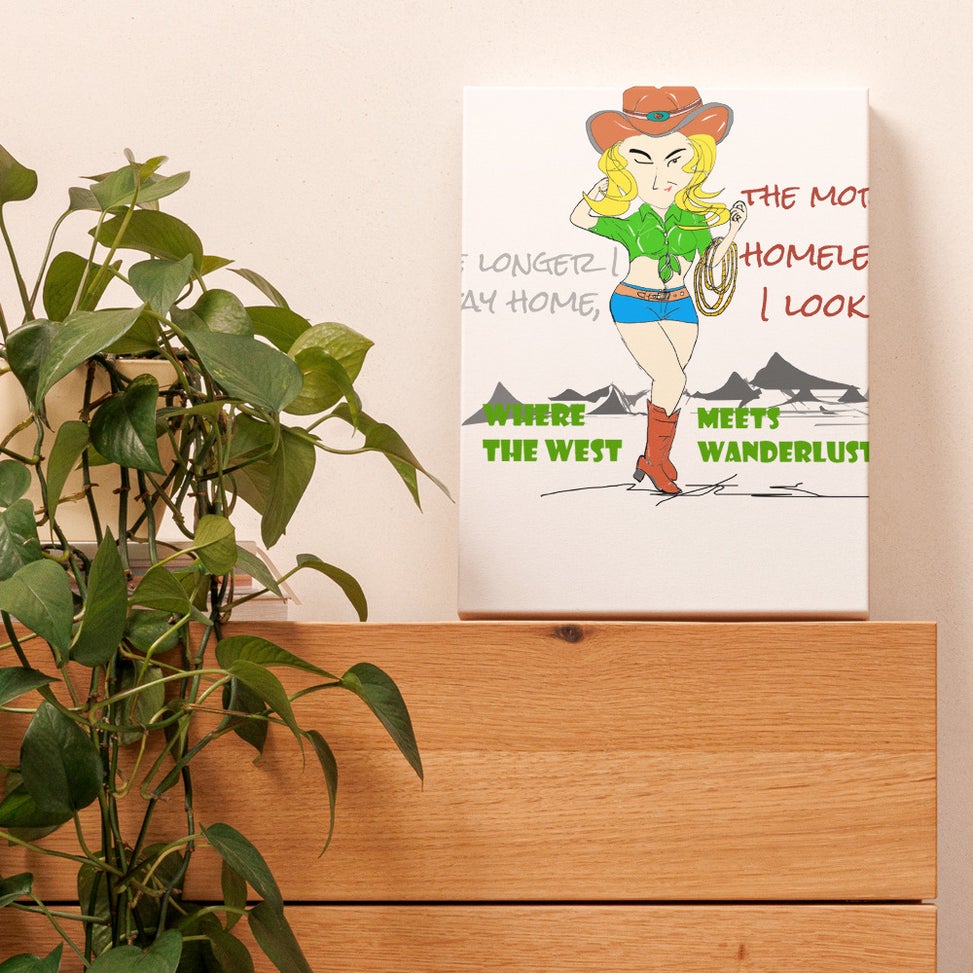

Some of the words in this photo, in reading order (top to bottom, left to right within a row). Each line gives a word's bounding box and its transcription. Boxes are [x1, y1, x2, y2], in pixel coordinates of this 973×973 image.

[741, 184, 800, 210] THE
[479, 251, 606, 277] LONGER
[612, 246, 619, 277] I
[739, 241, 869, 271] HOMELE
[461, 289, 496, 314] AY
[506, 289, 600, 322] HOME,
[761, 286, 769, 321] I
[785, 294, 869, 318] LOOK
[482, 403, 586, 427] WHERE
[697, 407, 781, 430] MEETS
[482, 439, 538, 462] THE
[545, 439, 622, 463] WEST
[697, 440, 870, 464] WANDERLUST
